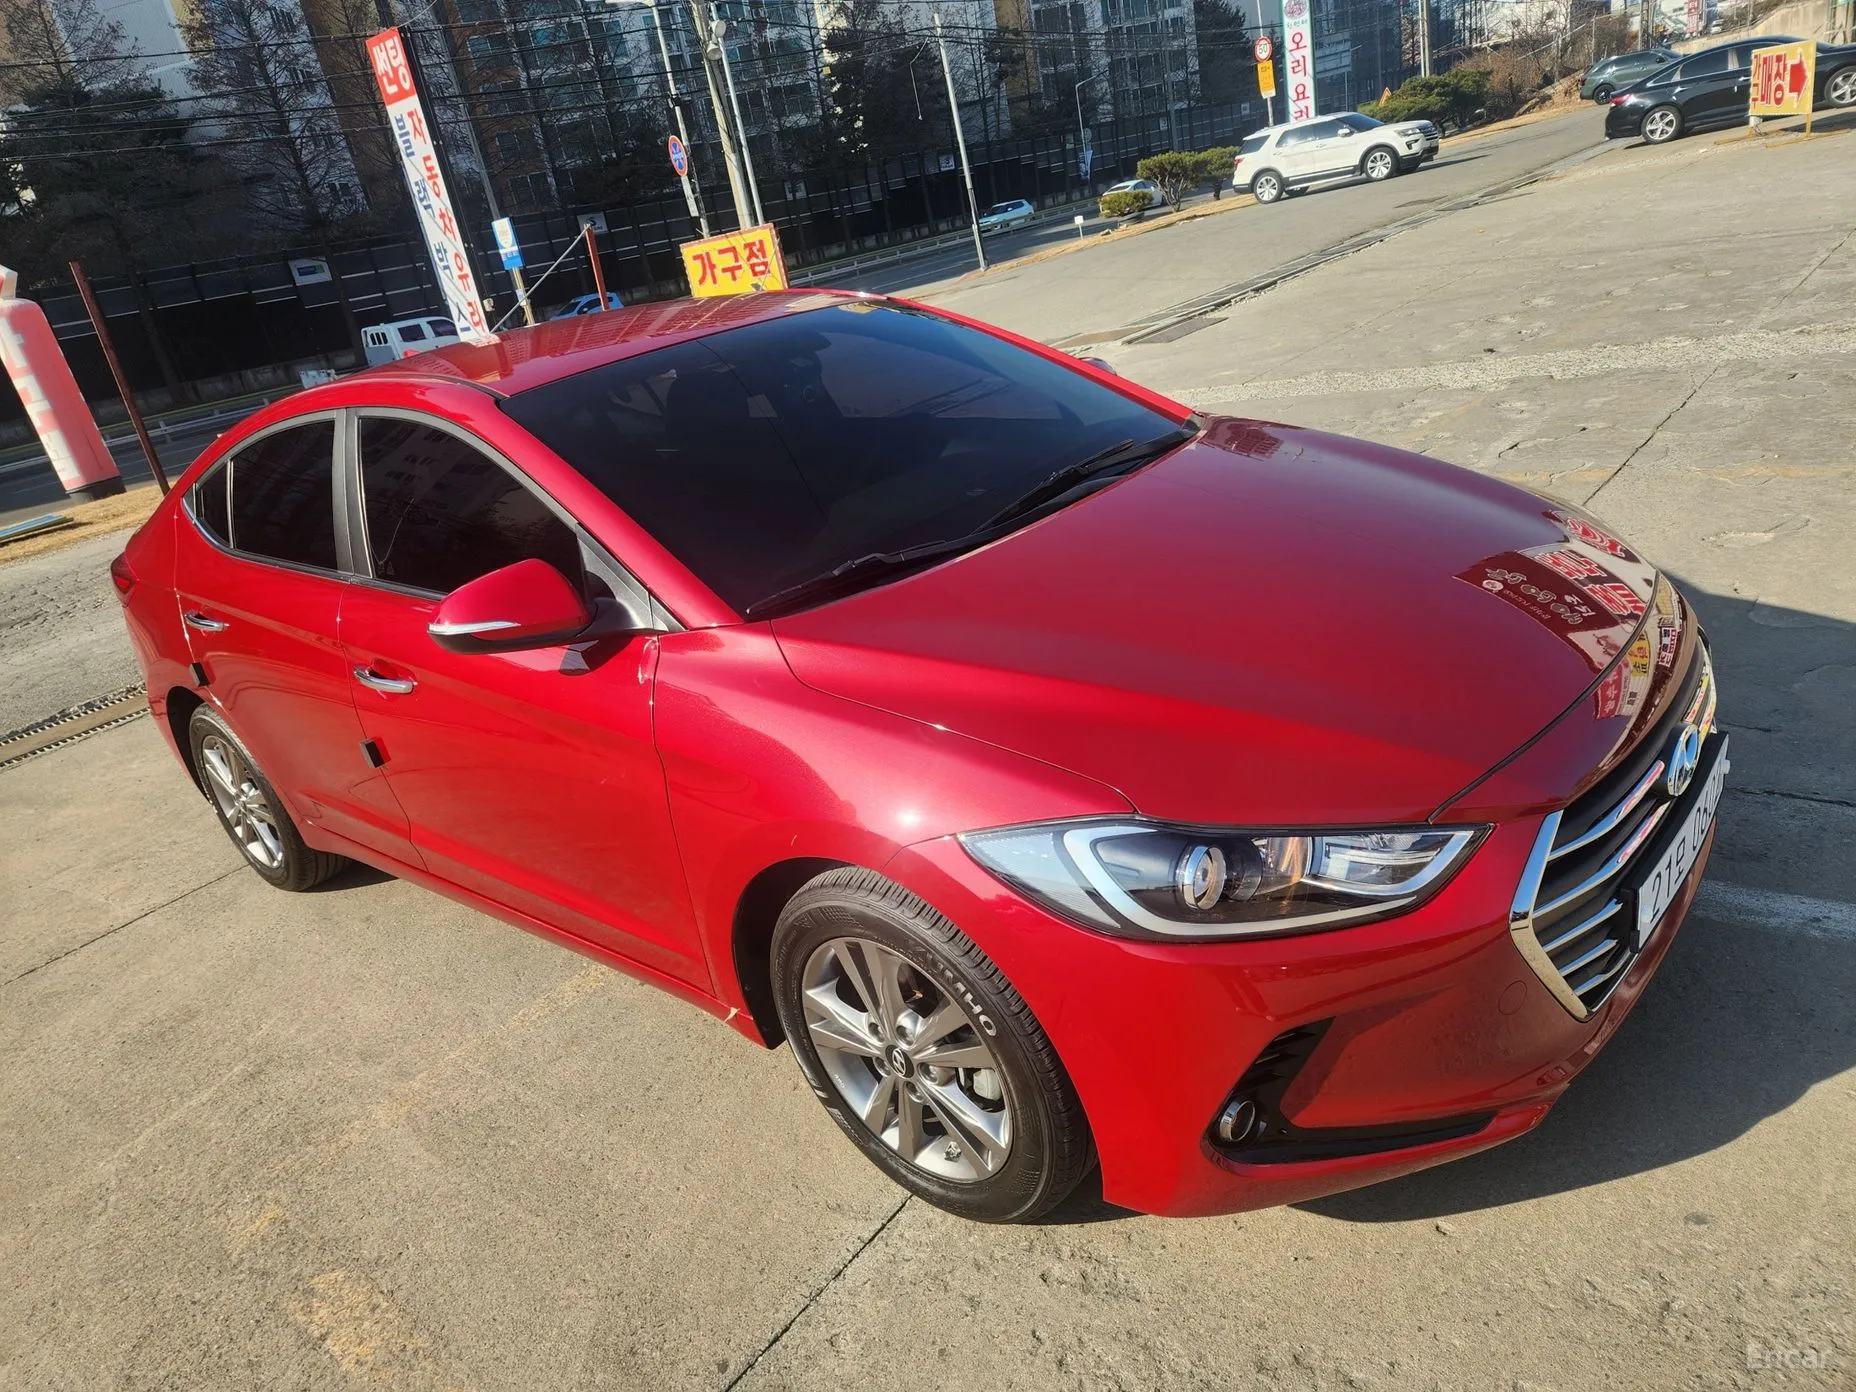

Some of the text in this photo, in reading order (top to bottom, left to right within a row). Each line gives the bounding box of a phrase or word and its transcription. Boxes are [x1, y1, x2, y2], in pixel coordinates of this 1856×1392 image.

[372, 36, 411, 94] 썬팅
[407, 108, 486, 333] 자동차유리
[692, 239, 771, 285] 가구점
